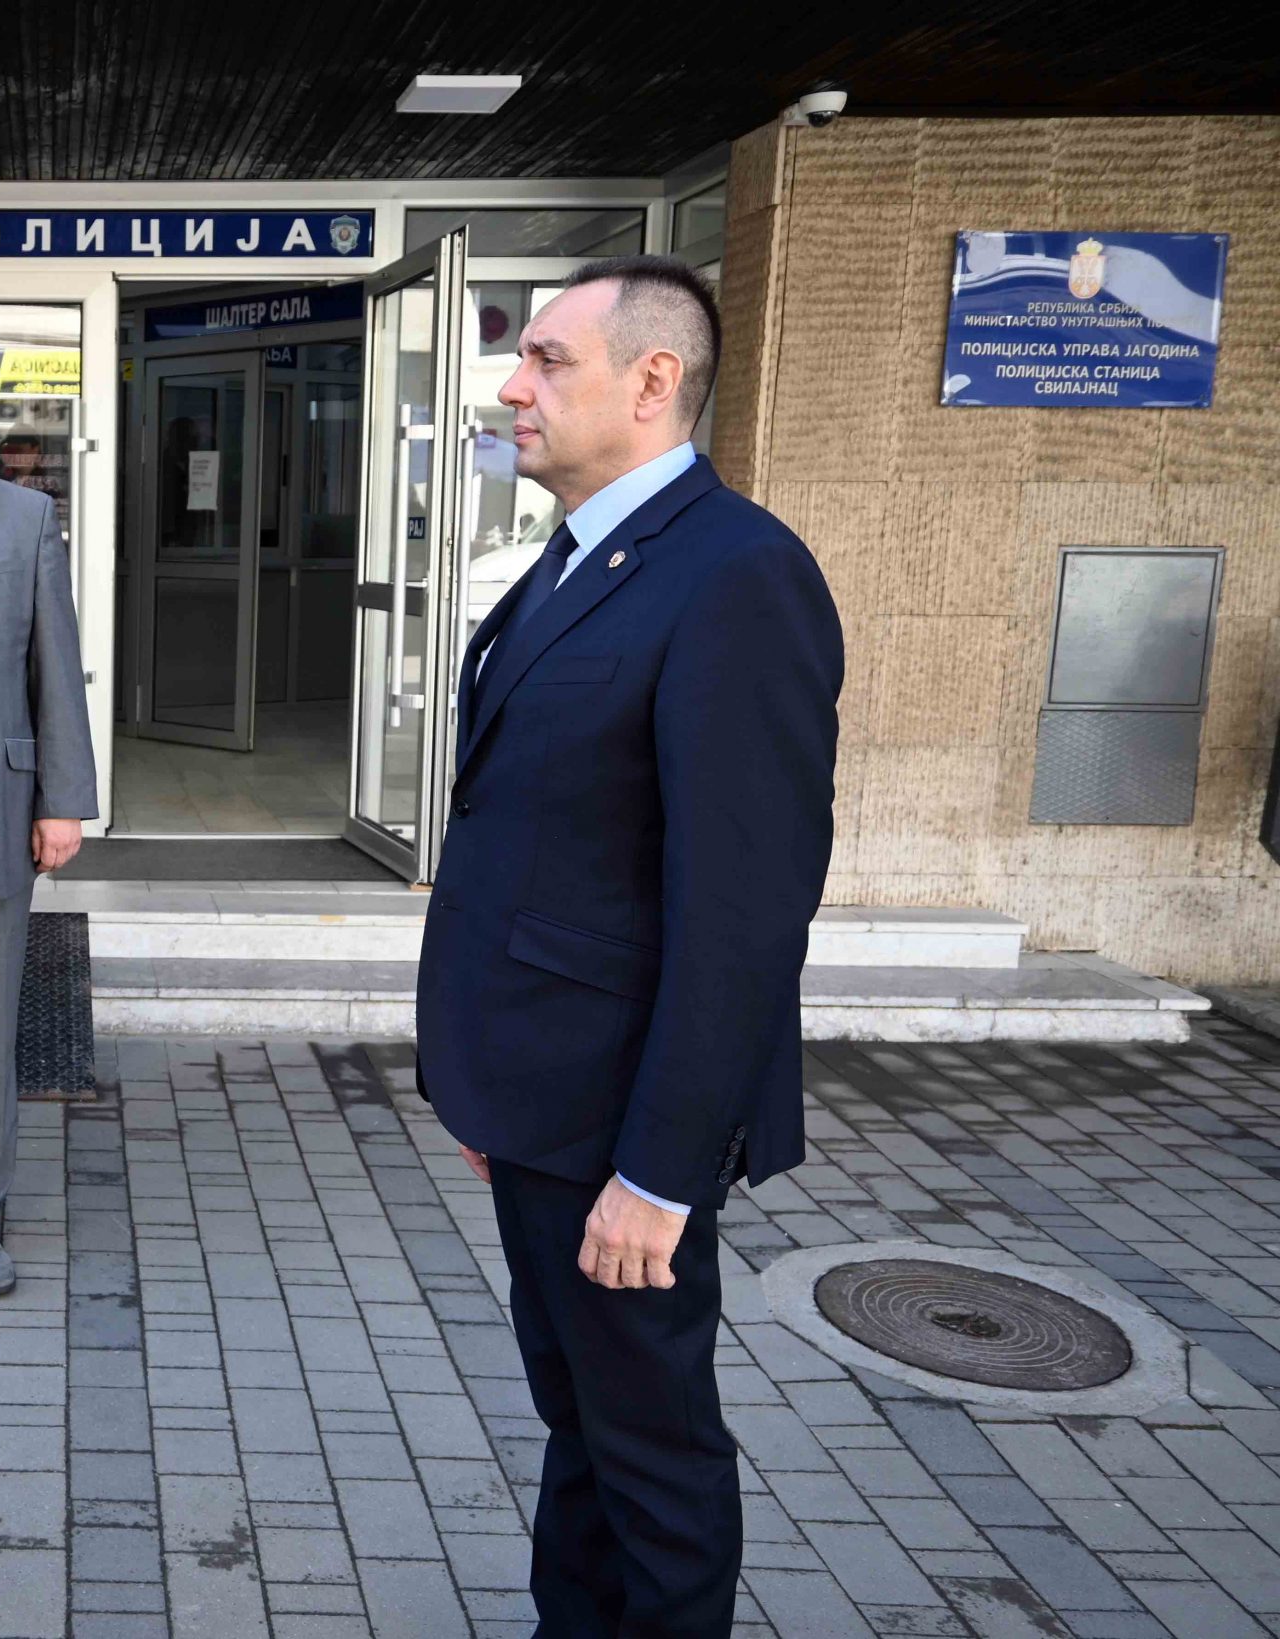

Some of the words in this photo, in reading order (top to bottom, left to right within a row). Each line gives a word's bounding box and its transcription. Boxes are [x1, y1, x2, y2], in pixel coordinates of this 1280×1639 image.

[205, 302, 267, 329] ШАЛТЕР
[270, 295, 311, 321] САЛА
[1027, 302, 1095, 314] РЕПУБЛИКА
[964, 315, 1058, 327] МИНИСТАРСТВО
[1061, 316, 1143, 328] УНУТРАШЊИХ
[961, 342, 1058, 358] ПОЛИЦИЈСКА
[1062, 343, 1121, 358] УПРАВА
[1124, 344, 1200, 360] ЈАГОДИНА
[995, 364, 1090, 381] ПОЛИЦИЈСКА
[1093, 365, 1161, 382] СТАНИЦА
[1034, 380, 1119, 396] СВИЛАЈНАЦ
